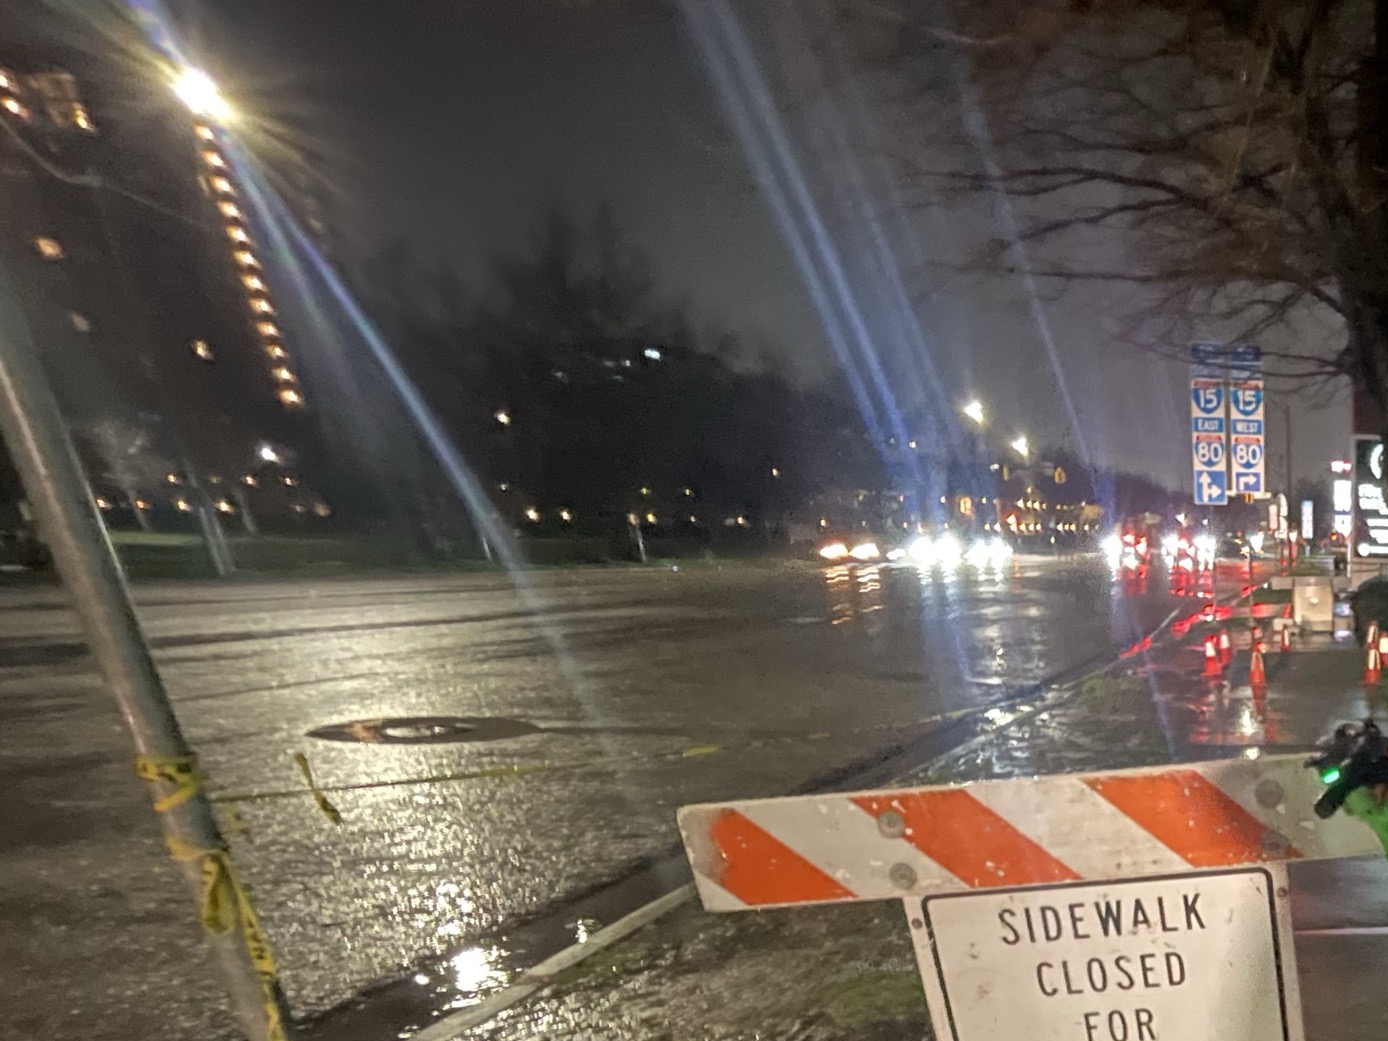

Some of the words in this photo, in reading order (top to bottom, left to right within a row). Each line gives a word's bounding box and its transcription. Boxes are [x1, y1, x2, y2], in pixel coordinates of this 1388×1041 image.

[1199, 389, 1218, 409] 15
[1237, 390, 1256, 411] 15
[1197, 418, 1219, 431] EAST
[1235, 421, 1259, 433] WEST
[1198, 442, 1222, 462] 80
[1236, 444, 1260, 464] 80
[998, 892, 1207, 946] SIDEWALK
[1036, 951, 1186, 998] CLOSED
